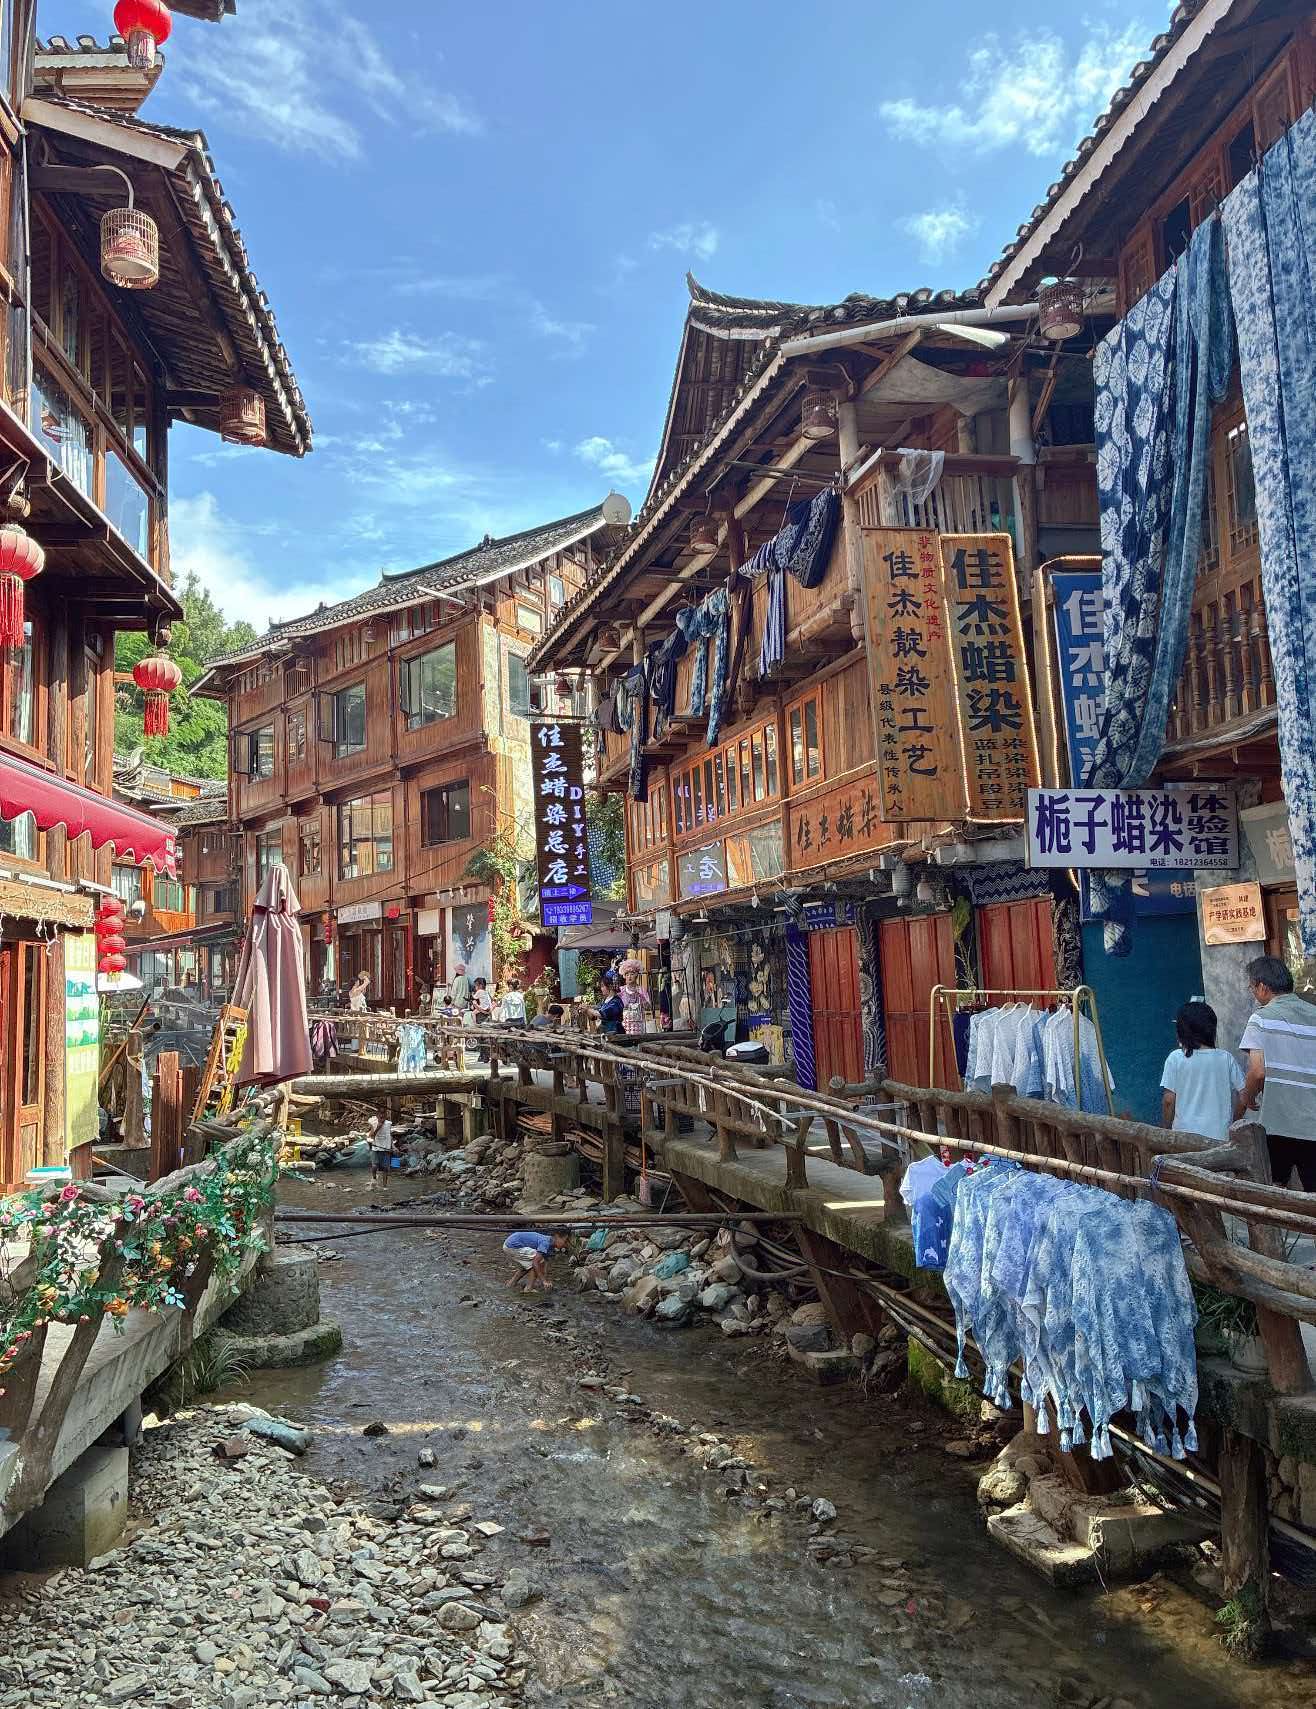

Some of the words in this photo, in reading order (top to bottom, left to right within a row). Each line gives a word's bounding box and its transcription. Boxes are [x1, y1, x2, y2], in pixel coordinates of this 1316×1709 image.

[882, 550, 938, 776] 佳杰靛染工艺
[951, 549, 1024, 734] 佳杰蜡染
[878, 683, 904, 814] 县级代表性传承人
[1035, 793, 1184, 856] 栀子蜡染
[1187, 793, 1231, 856] 体验馆
